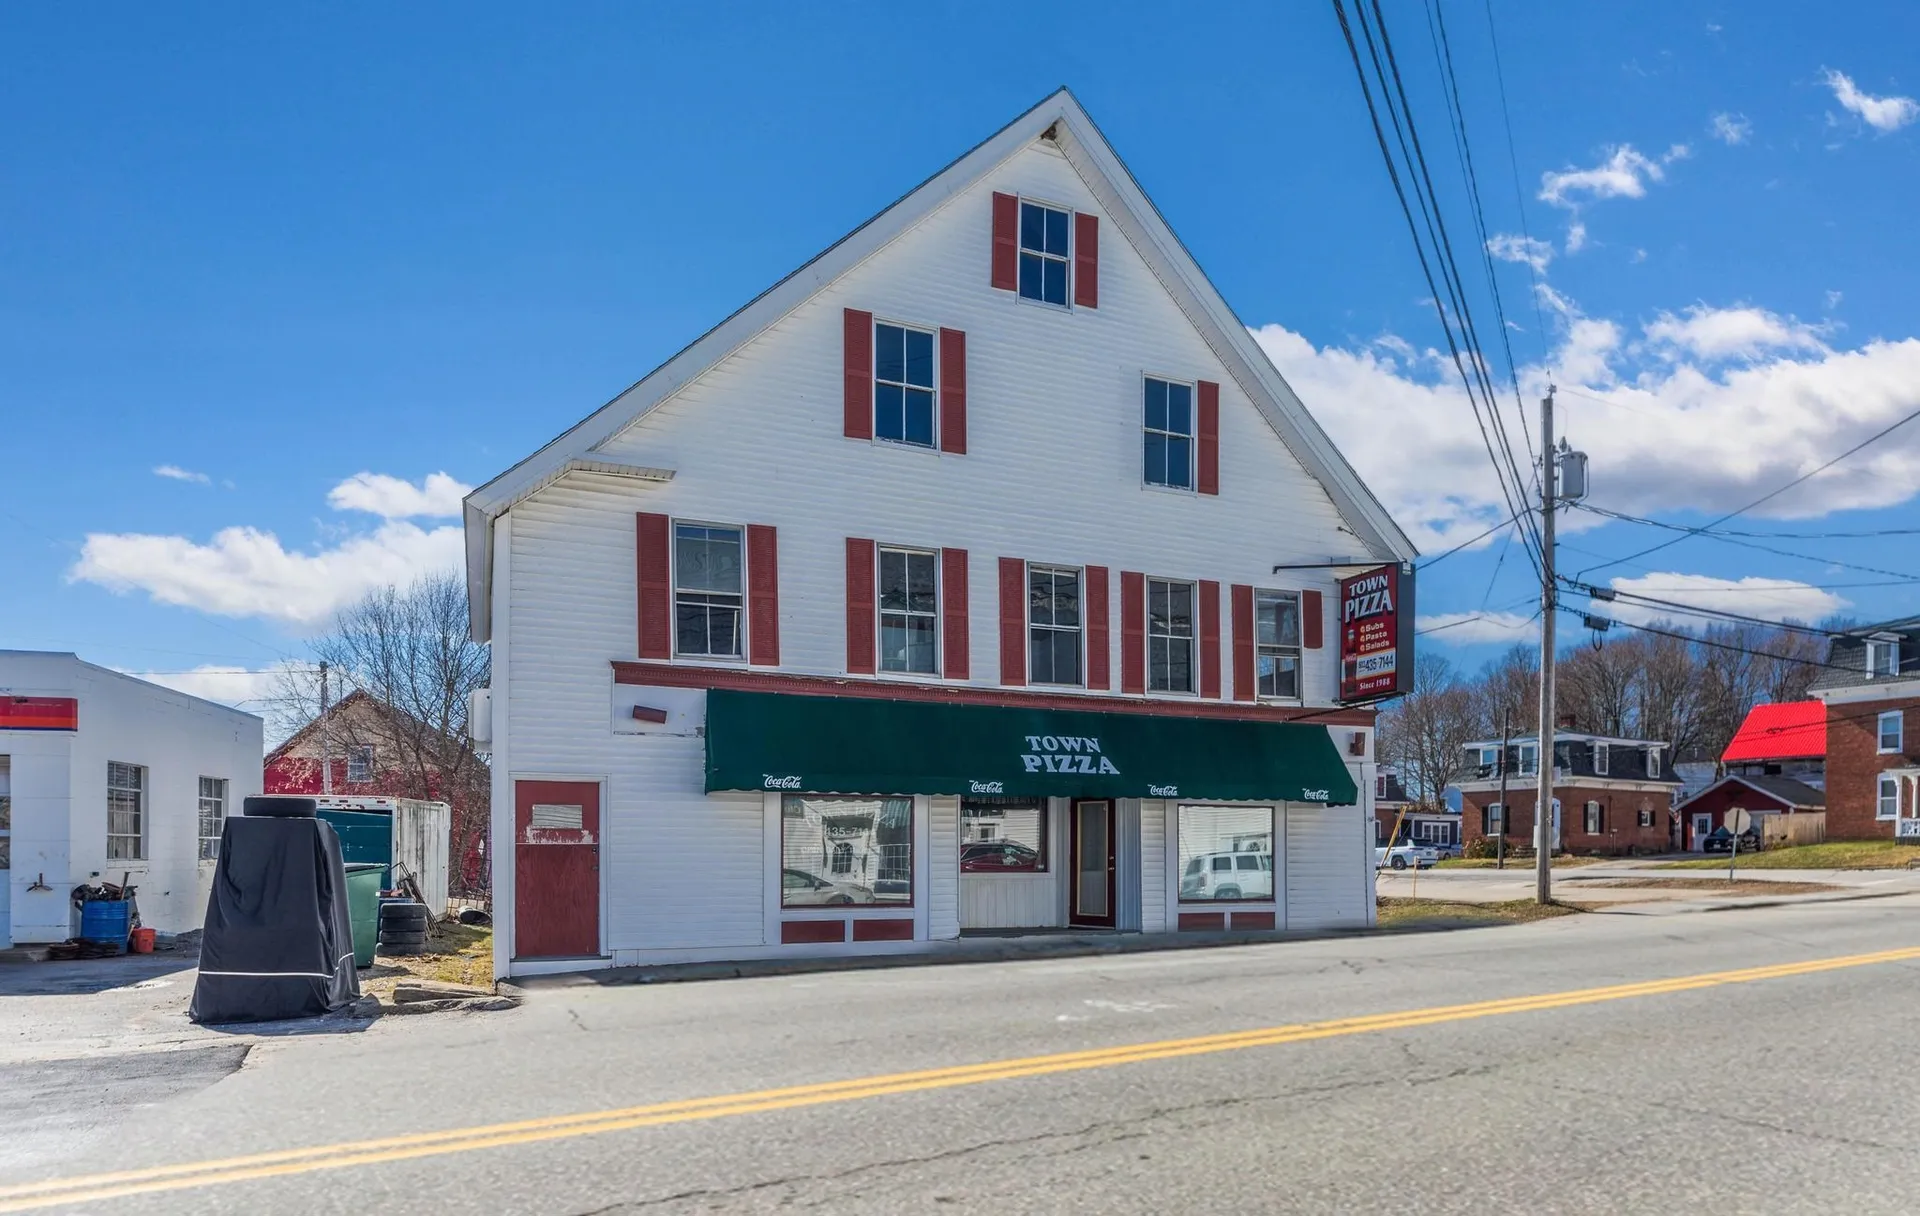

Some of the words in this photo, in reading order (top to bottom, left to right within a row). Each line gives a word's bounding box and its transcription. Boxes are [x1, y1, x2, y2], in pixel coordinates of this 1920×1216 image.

[1349, 575, 1388, 596] TOWN
[1345, 589, 1394, 623] PIZZA
[1366, 622, 1385, 632] Subs
[1366, 631, 1387, 641] Pasta
[1366, 640, 1390, 651] Salads
[1360, 682, 1374, 690] Since
[1025, 736, 1101, 753] TOWN
[1020, 755, 1120, 774] PIZZA
